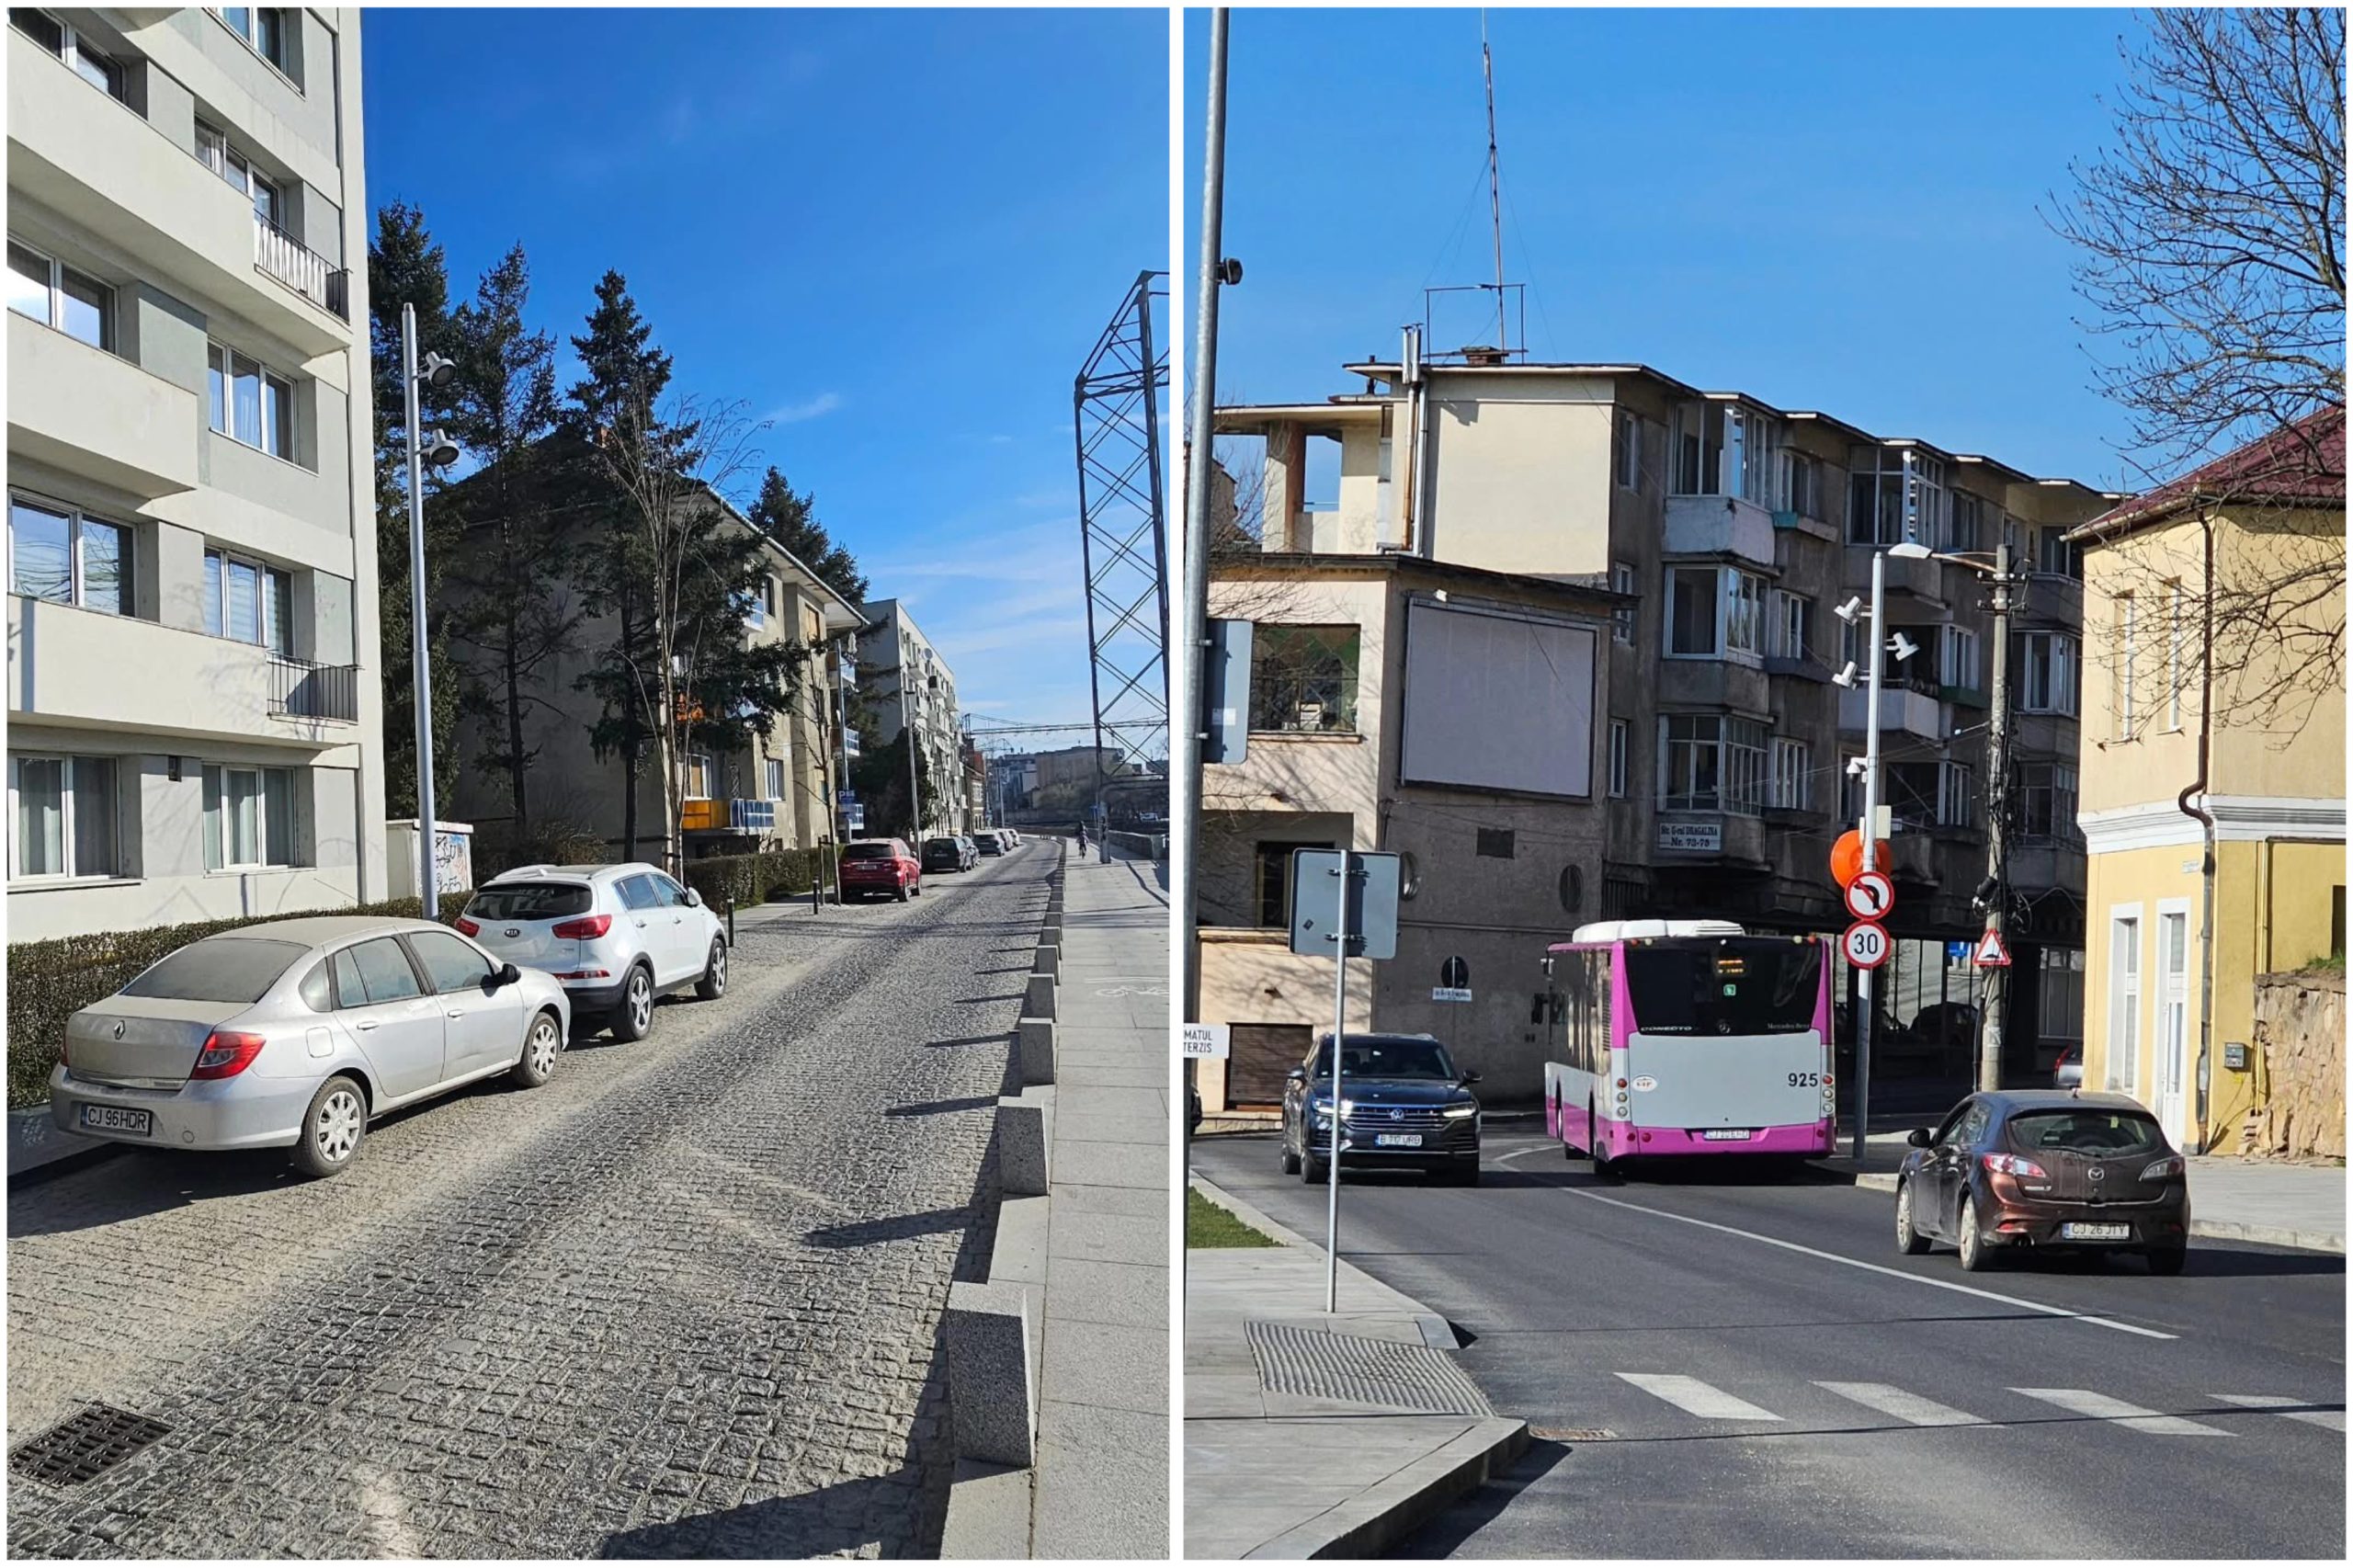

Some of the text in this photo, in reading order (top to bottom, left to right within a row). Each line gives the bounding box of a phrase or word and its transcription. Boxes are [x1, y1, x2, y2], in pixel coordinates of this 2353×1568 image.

[1854, 933, 1879, 955] 30
[1184, 1029, 1213, 1040] MATUL
[1184, 1041, 1212, 1053] TERZIS
[1788, 1073, 1819, 1087] 925
[88, 1108, 103, 1124] CJ
[2072, 1223, 2087, 1235] CJ
[2090, 1223, 2103, 1235] 26
